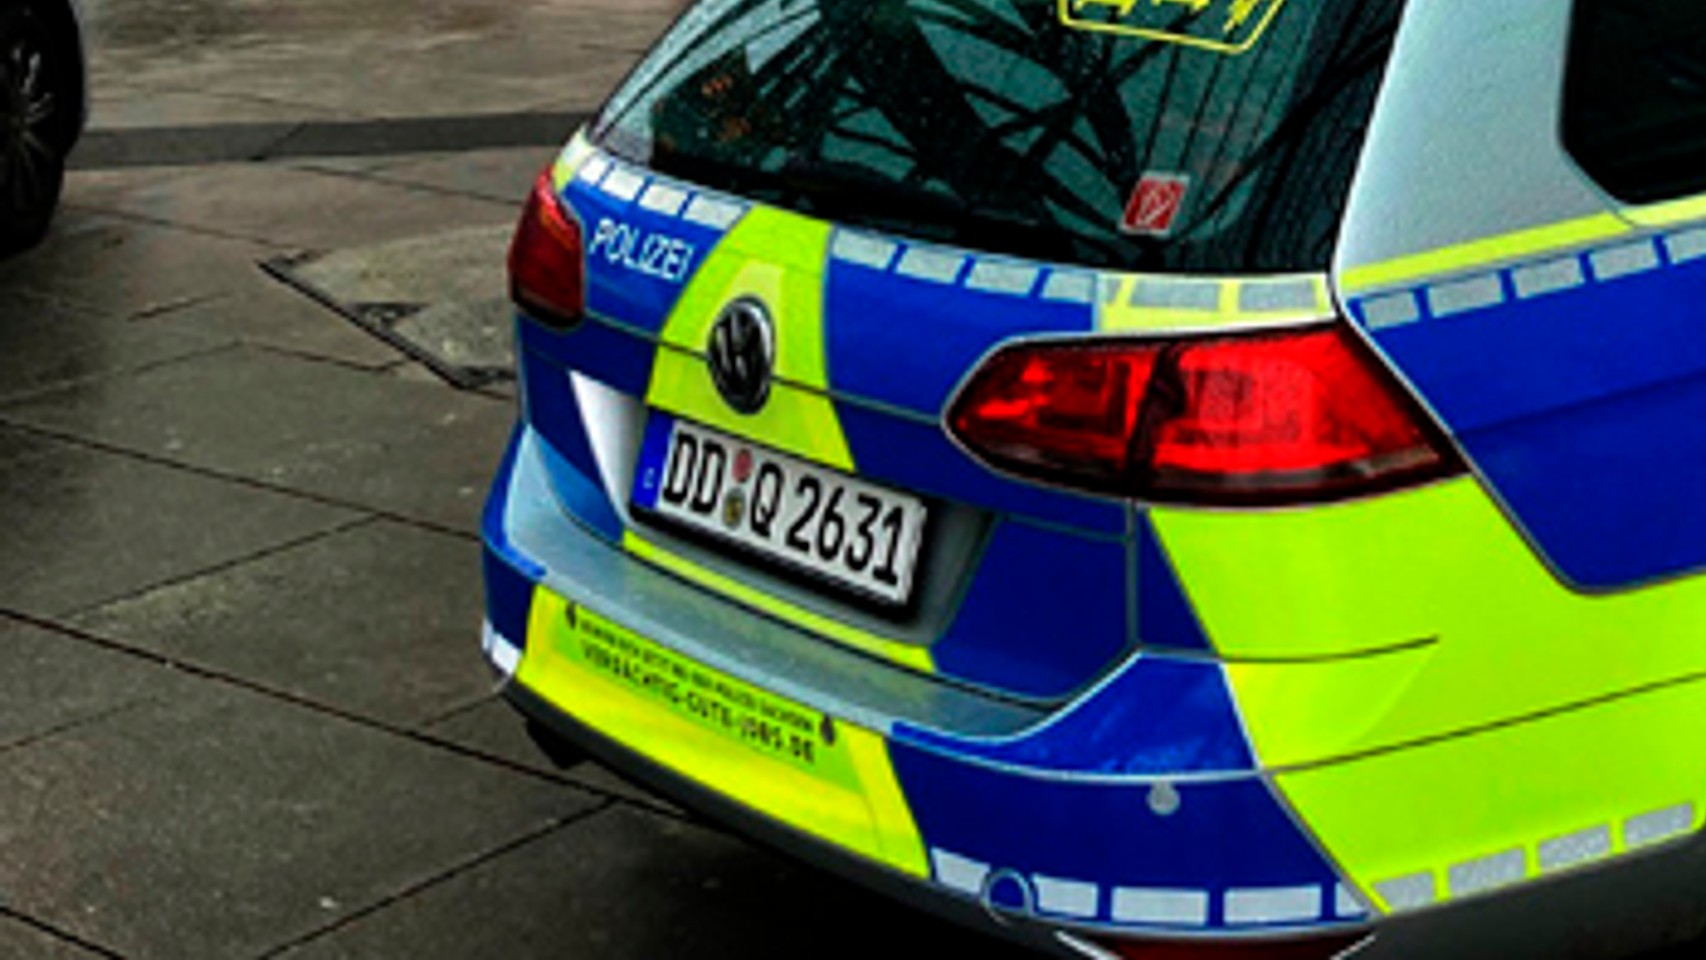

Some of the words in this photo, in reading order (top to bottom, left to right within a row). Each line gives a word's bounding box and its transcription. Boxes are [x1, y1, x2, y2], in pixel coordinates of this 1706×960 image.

[588, 217, 694, 282] POLIZEI
[662, 429, 726, 515] DD
[751, 461, 784, 539] Q
[785, 474, 904, 586] 2631
